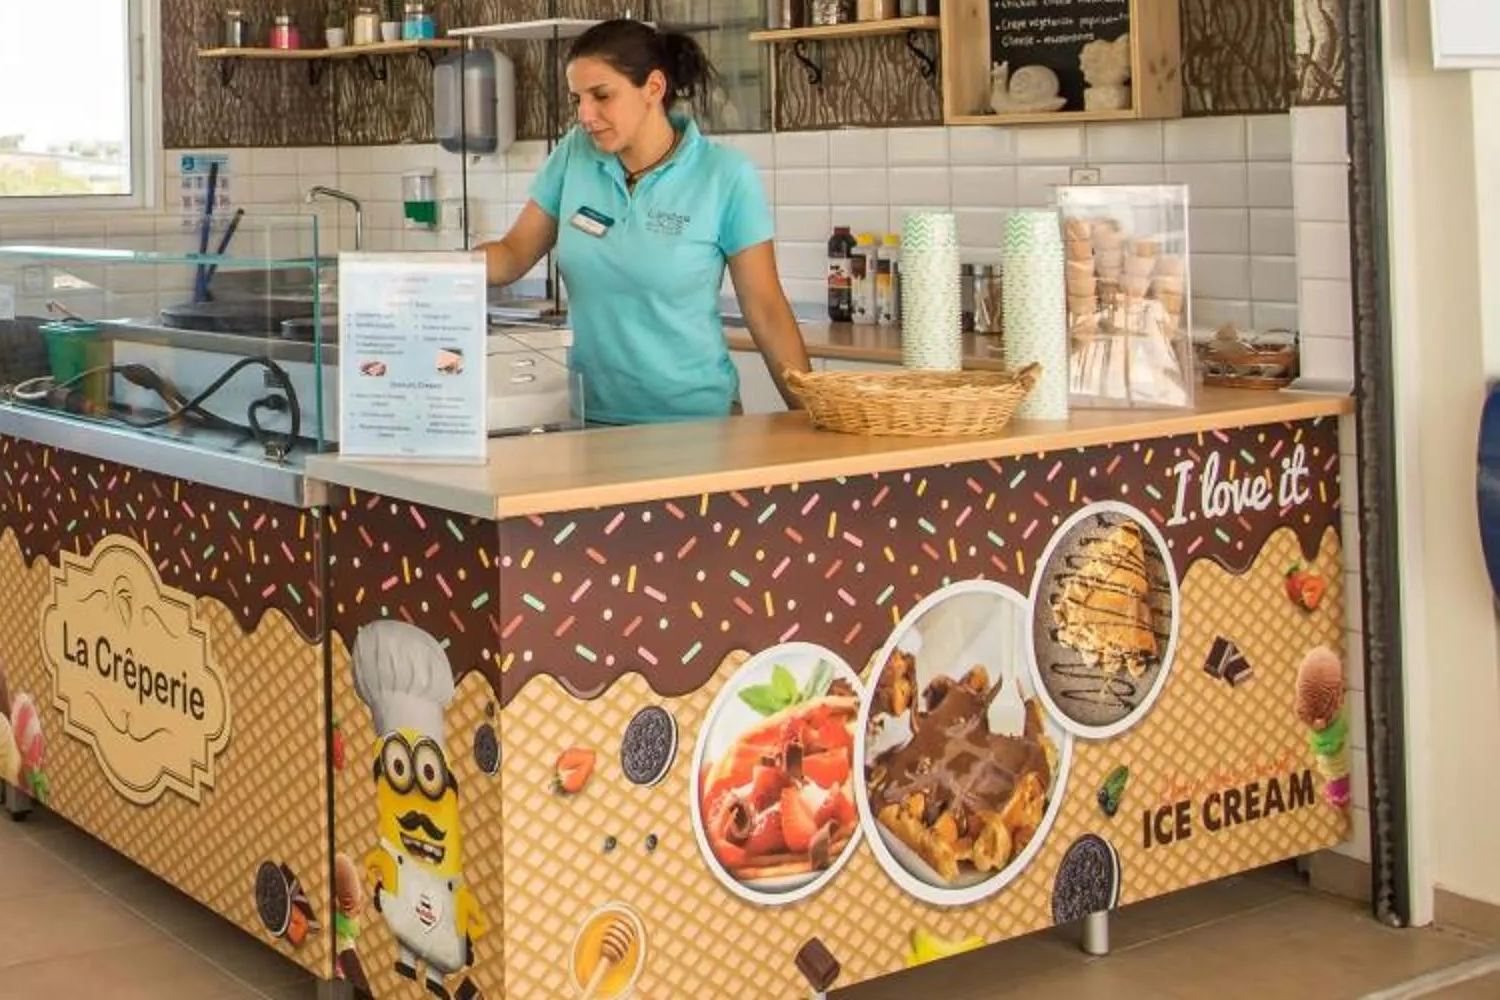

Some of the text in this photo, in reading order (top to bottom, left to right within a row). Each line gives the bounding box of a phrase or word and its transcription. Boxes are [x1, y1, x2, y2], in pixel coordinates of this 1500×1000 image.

[1166, 443, 1309, 526] I love it
[63, 620, 205, 722] La Crêperie
[1143, 800, 1191, 849] ICE
[1203, 769, 1315, 832] CREAM
